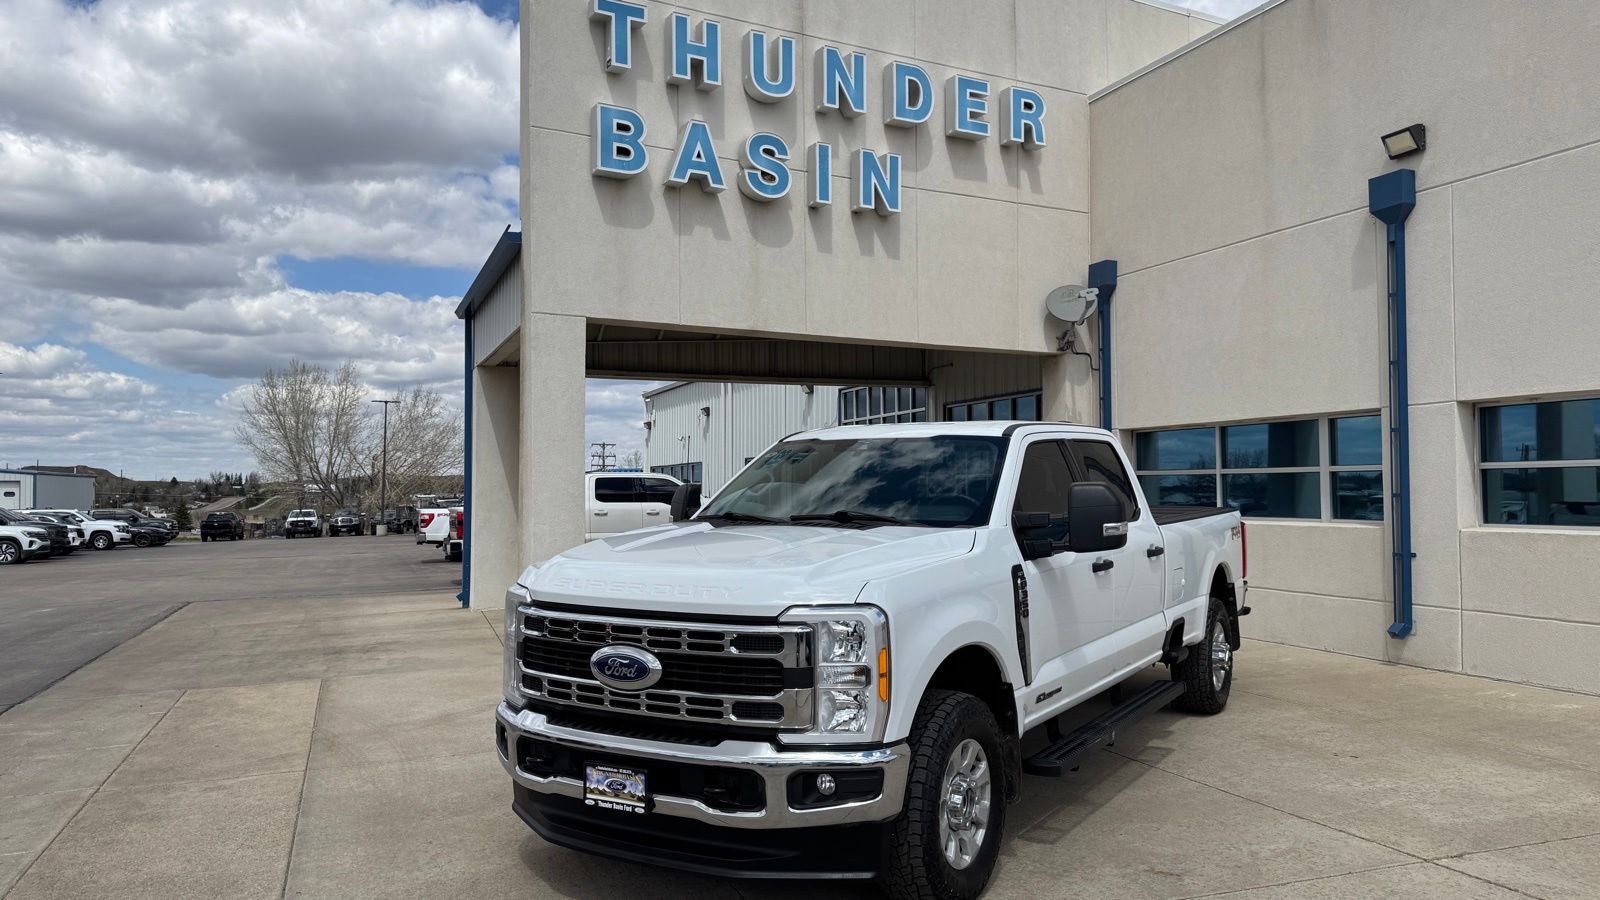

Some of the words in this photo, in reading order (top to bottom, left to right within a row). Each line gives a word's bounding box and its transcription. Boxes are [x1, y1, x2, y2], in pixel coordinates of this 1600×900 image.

[590, 0, 1047, 150] THUNDER
[592, 102, 902, 216] BASIN
[553, 577, 649, 593] SUPER
[653, 583, 743, 599] DUTY
[604, 657, 638, 677] Ford
